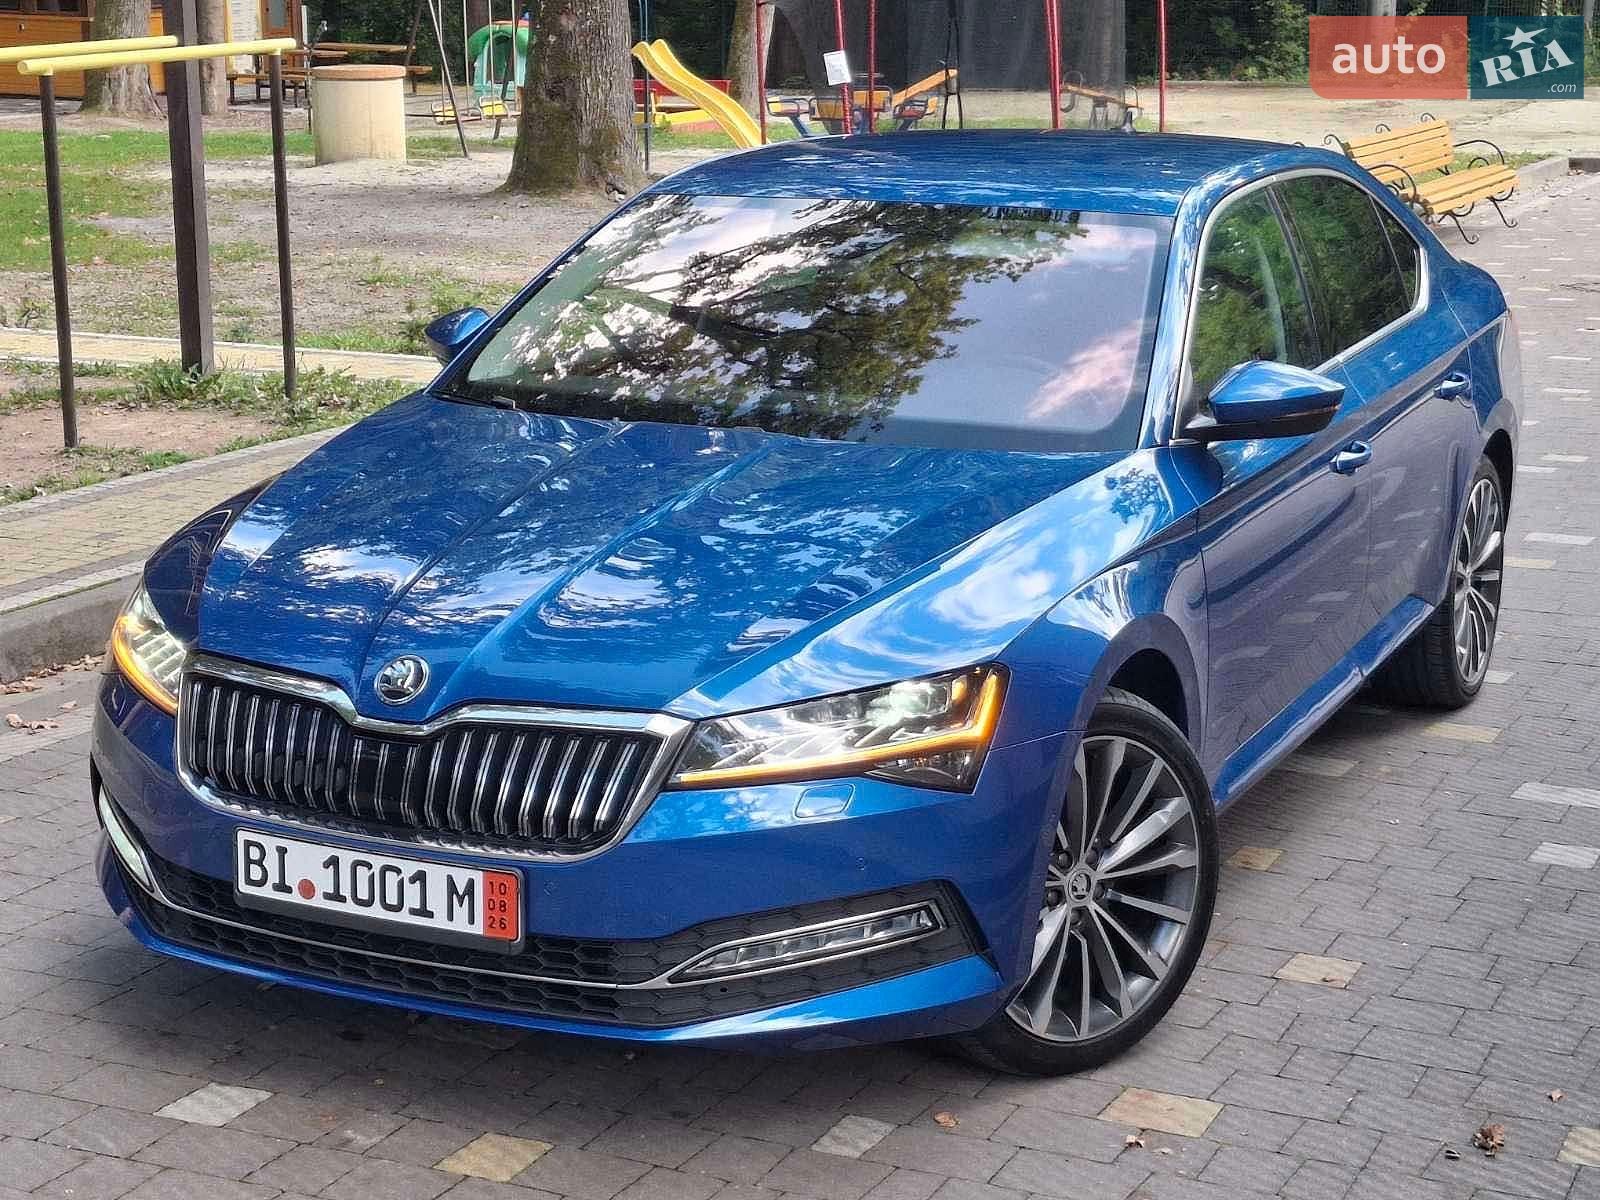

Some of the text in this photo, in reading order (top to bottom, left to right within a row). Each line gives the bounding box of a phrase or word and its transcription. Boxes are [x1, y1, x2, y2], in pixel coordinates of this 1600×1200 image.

[243, 838, 475, 926] BI 1001 M
[488, 881, 507, 895] 10
[488, 898, 507, 913] 08
[488, 915, 507, 930] 26
